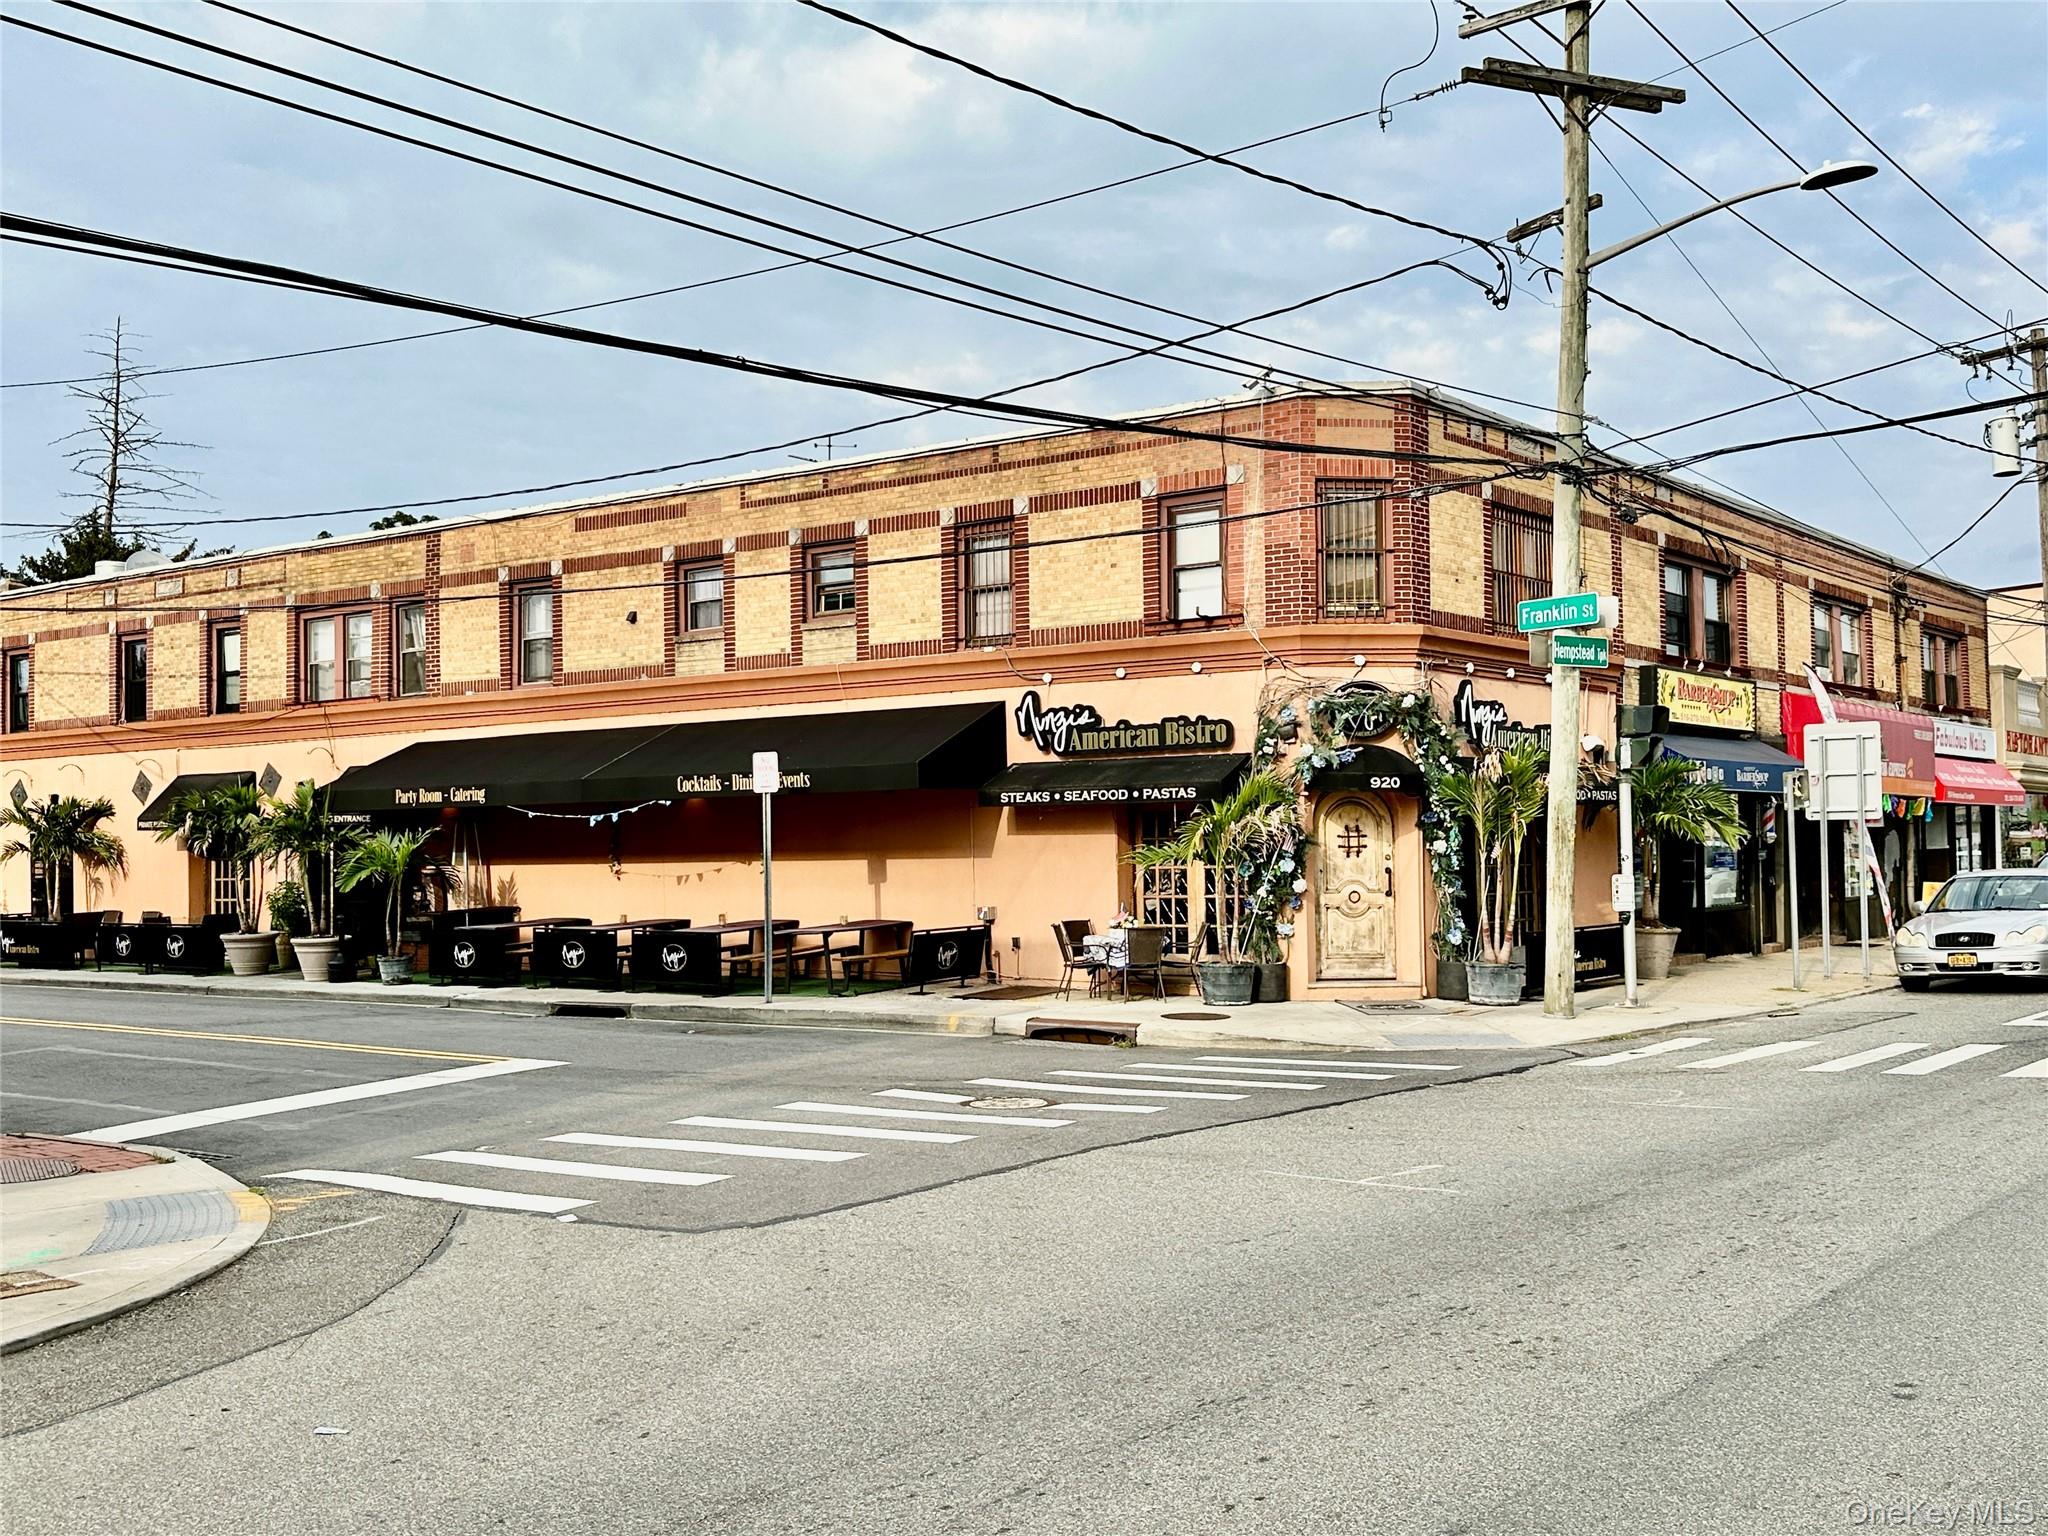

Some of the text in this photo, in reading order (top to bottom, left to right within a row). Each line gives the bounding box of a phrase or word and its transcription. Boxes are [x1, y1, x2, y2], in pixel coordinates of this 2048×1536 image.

[1522, 603, 1594, 625] Franklin St
[1553, 641, 1607, 664] Hempstead Tpk
[1068, 719, 1227, 751] American Bistro
[1935, 727, 1968, 750] Fabulous
[1968, 731, 1987, 752] Nails
[677, 774, 722, 792] Cocktails
[732, 773, 753, 791] Dini
[777, 771, 811, 788] Events
[1370, 776, 1400, 789] 920
[395, 789, 417, 807] Party
[419, 788, 442, 803] Room
[450, 786, 486, 804] Catering
[1000, 787, 1197, 803] STEAKS SEAFOOD PASTAS
[1591, 790, 1617, 801] PASTAS
[333, 815, 371, 823] ENTRANCE
